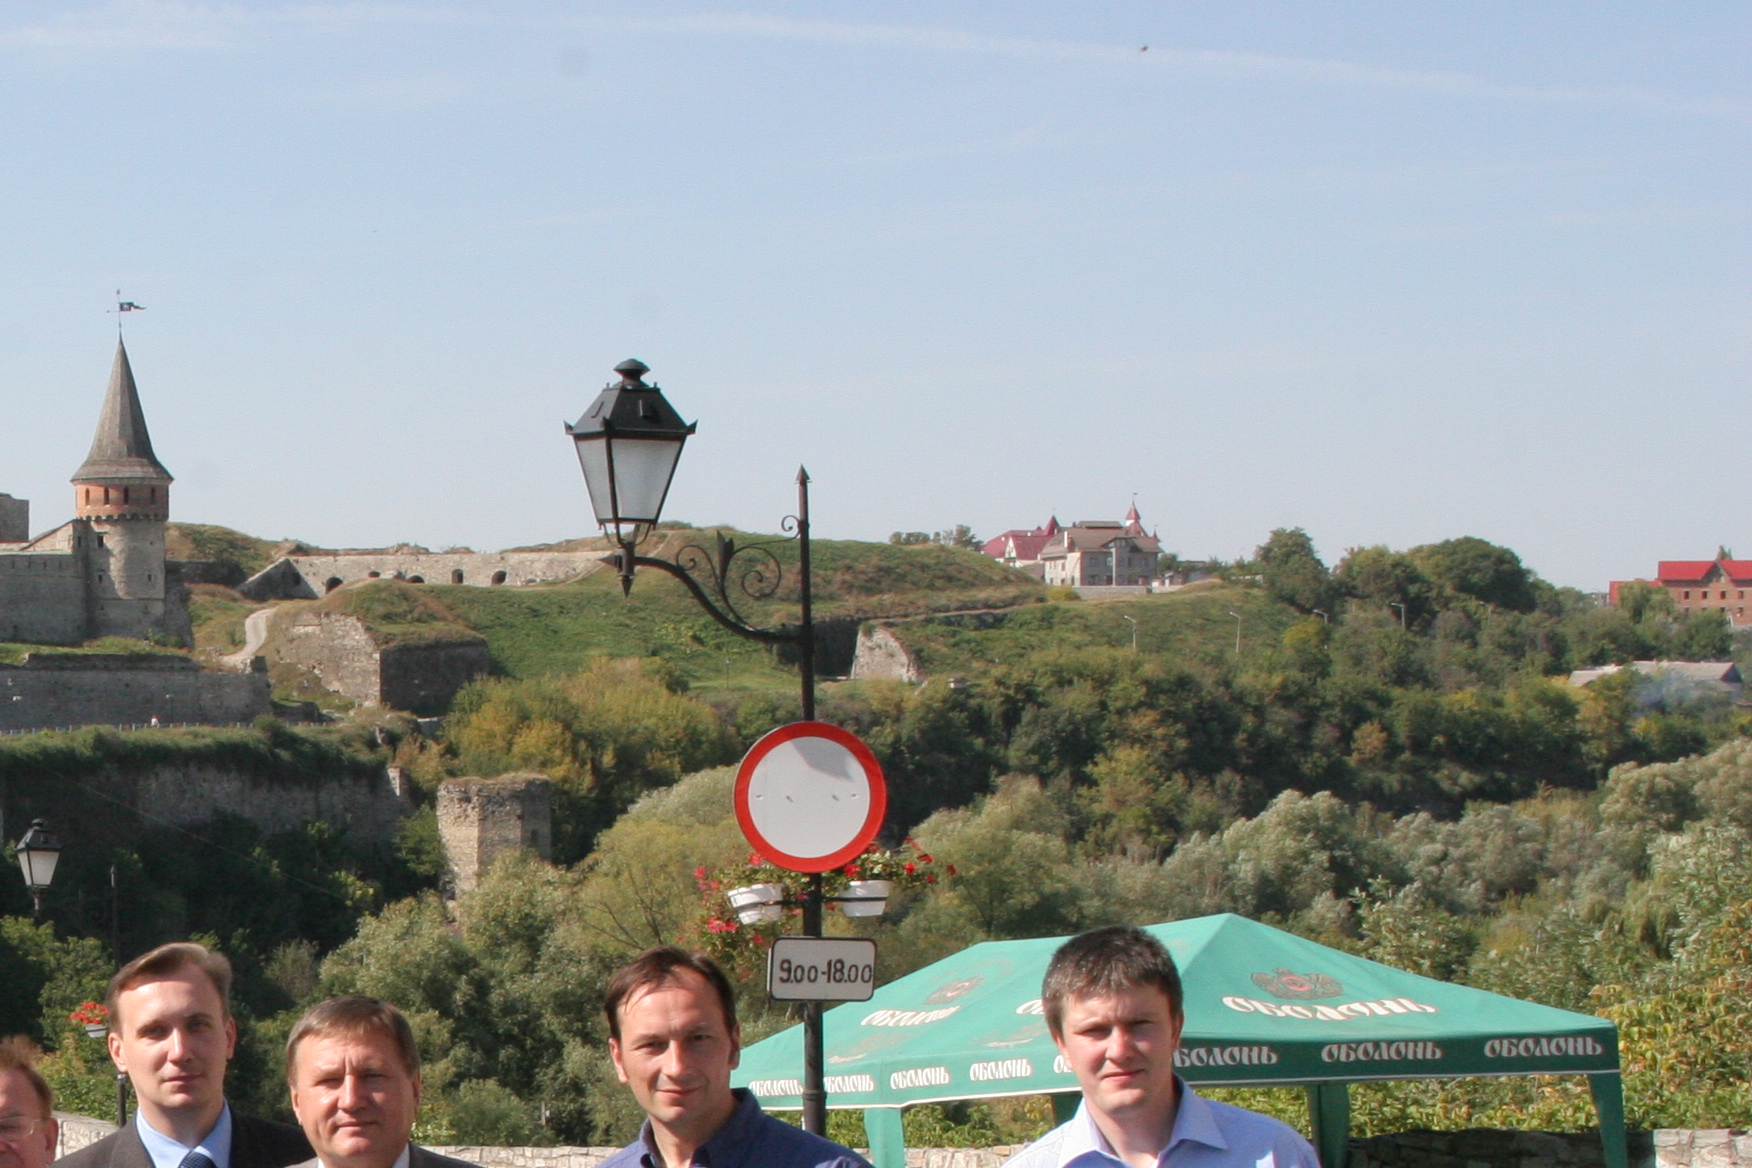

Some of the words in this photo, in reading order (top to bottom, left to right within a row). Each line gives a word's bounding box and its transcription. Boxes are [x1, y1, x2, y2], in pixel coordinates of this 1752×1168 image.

[780, 958, 873, 984] 9.00-18.00
[1221, 995, 1438, 1021] ОБОЛОНЬ
[1173, 1045, 1278, 1067] БОЛОНЬ
[1321, 1042, 1442, 1062] ОБОЛОНЬ
[1484, 1036, 1602, 1057] ОБОЛОНЬ
[890, 1066, 950, 1090] ОБОЛОНЬ
[969, 1058, 1031, 1081] ОБОЛОНЬ
